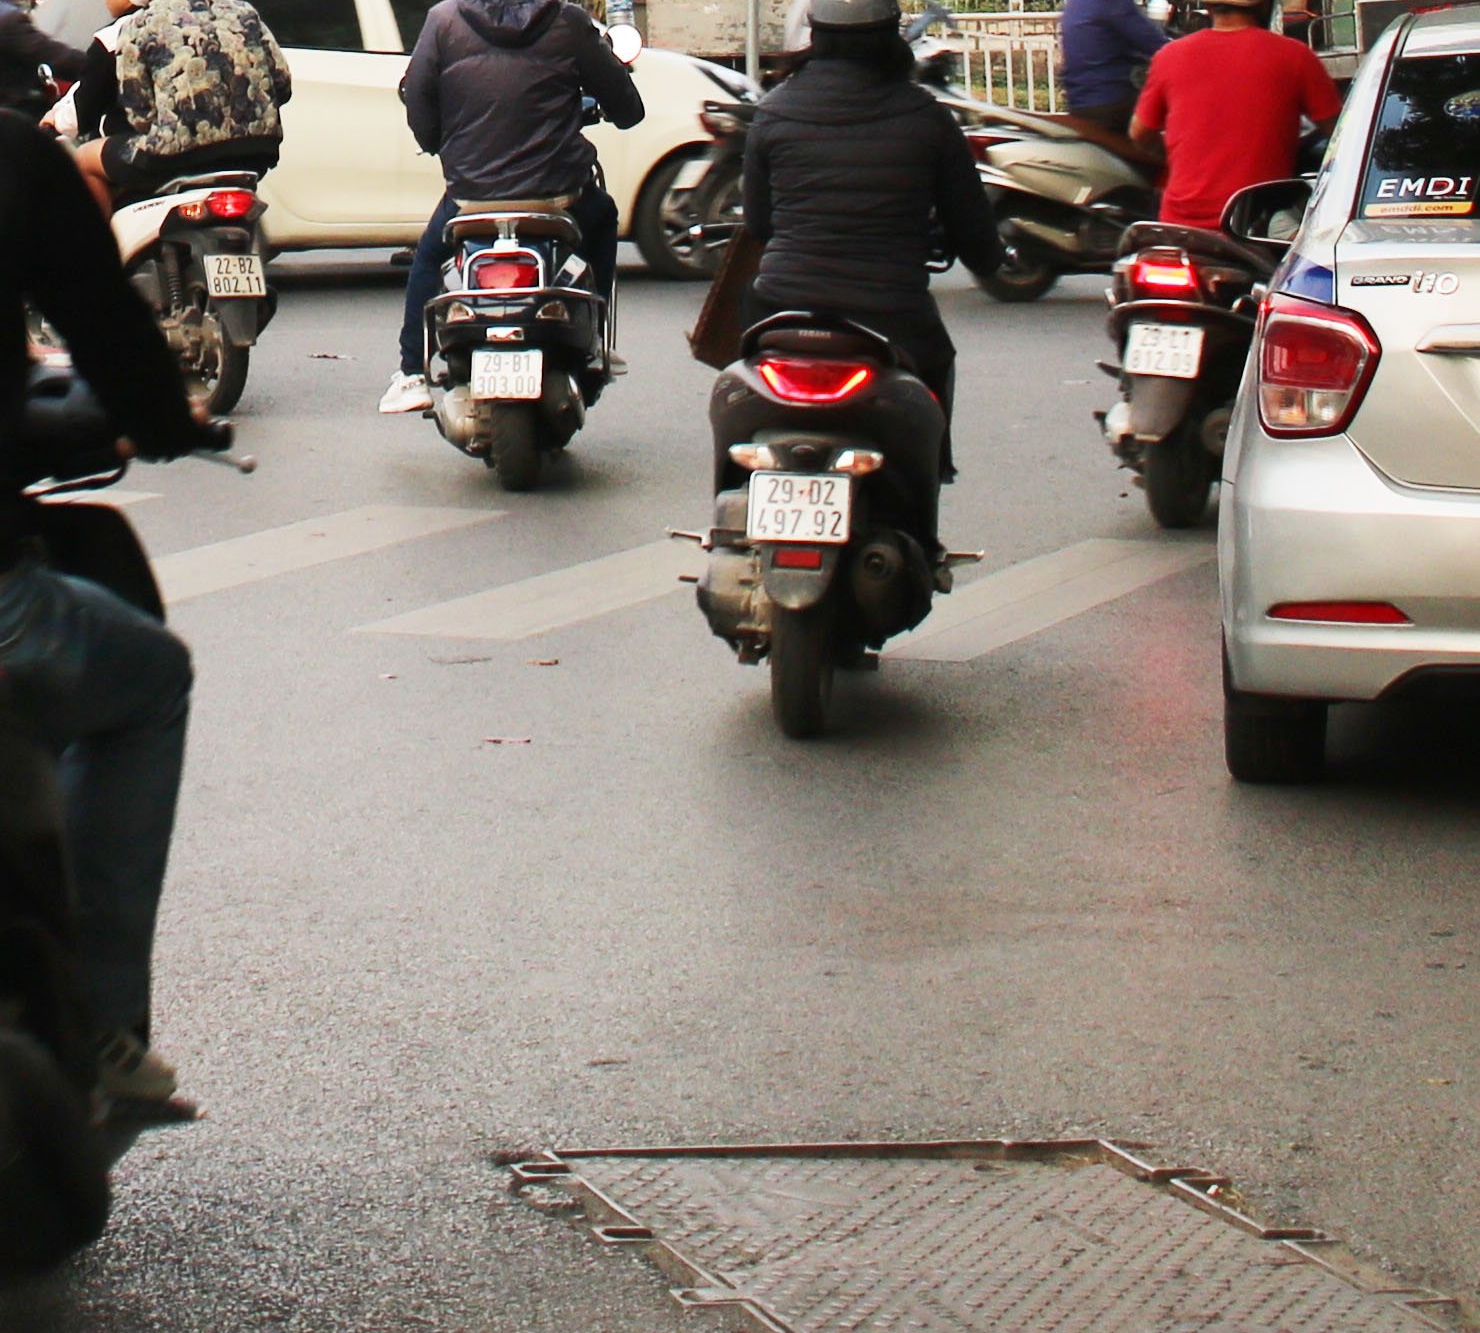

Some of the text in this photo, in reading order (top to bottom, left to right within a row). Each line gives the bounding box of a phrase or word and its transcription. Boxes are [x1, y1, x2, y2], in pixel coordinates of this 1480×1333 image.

[215, 257, 254, 275] 22-B2
[213, 276, 262, 294] 802.11
[767, 477, 835, 506] 29-D2
[757, 507, 843, 538] 497.92
